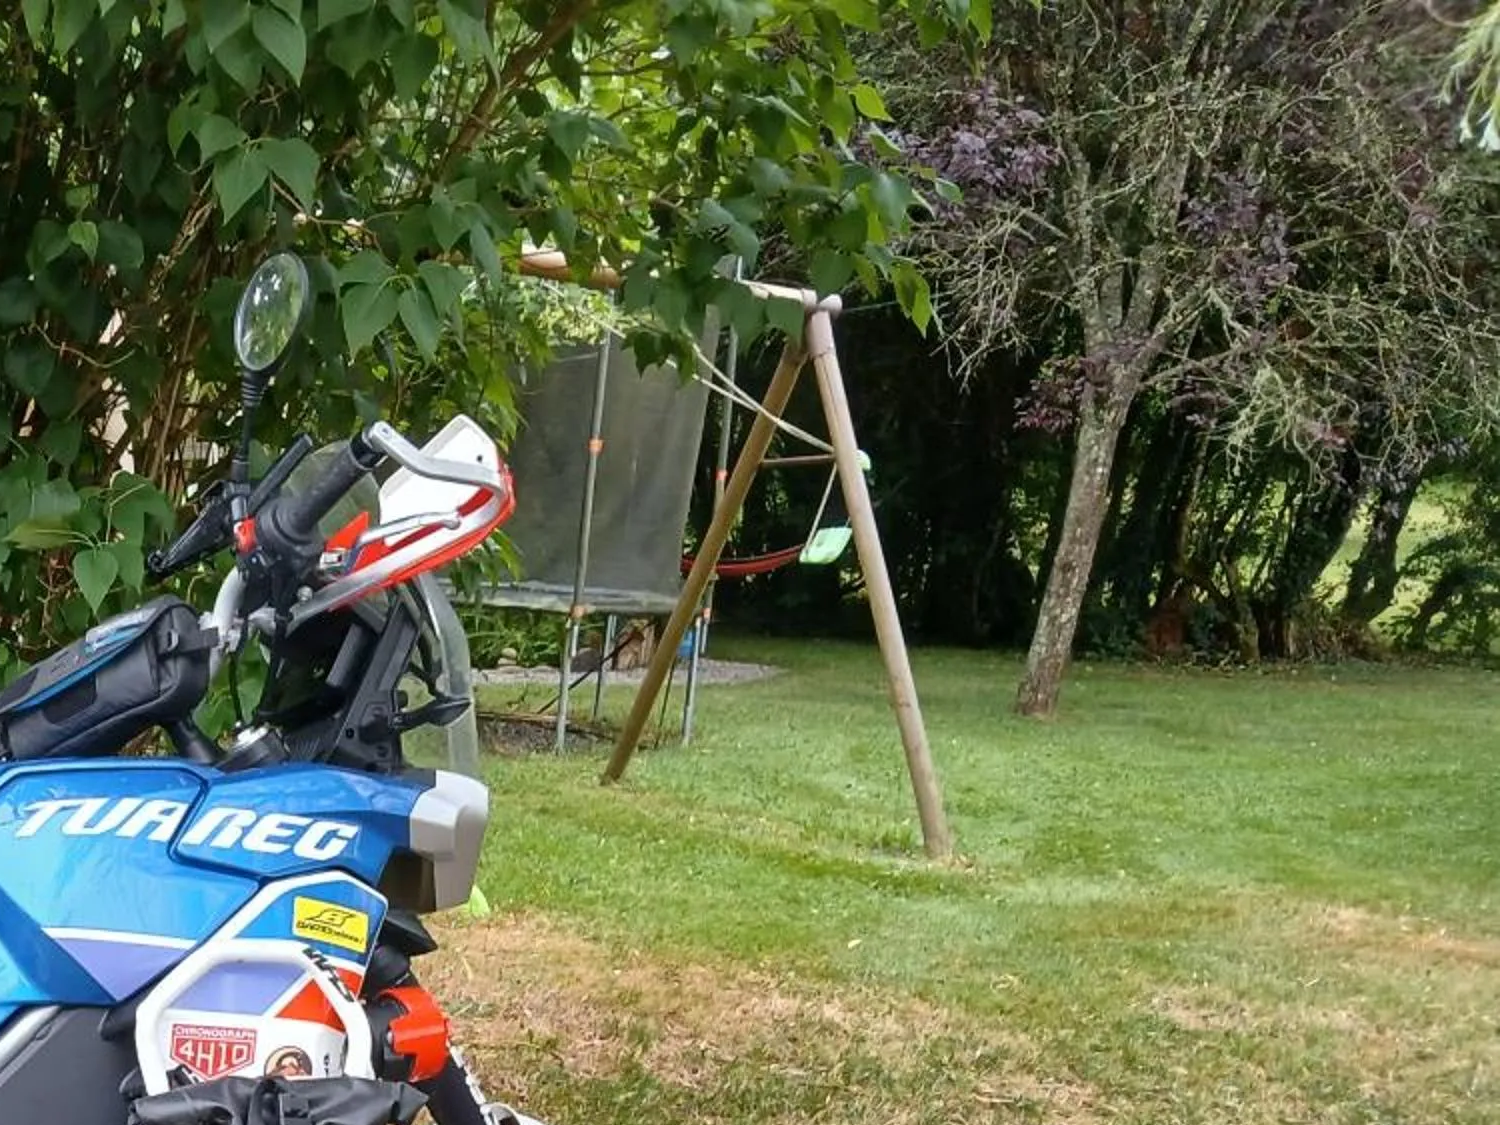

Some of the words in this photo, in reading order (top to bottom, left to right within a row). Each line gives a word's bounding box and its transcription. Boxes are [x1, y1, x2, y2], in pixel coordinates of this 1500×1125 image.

[14, 797, 359, 861] TUAREG
[174, 1026, 255, 1041] CHRONOGRAPH
[179, 1038, 248, 1076] 4H10
